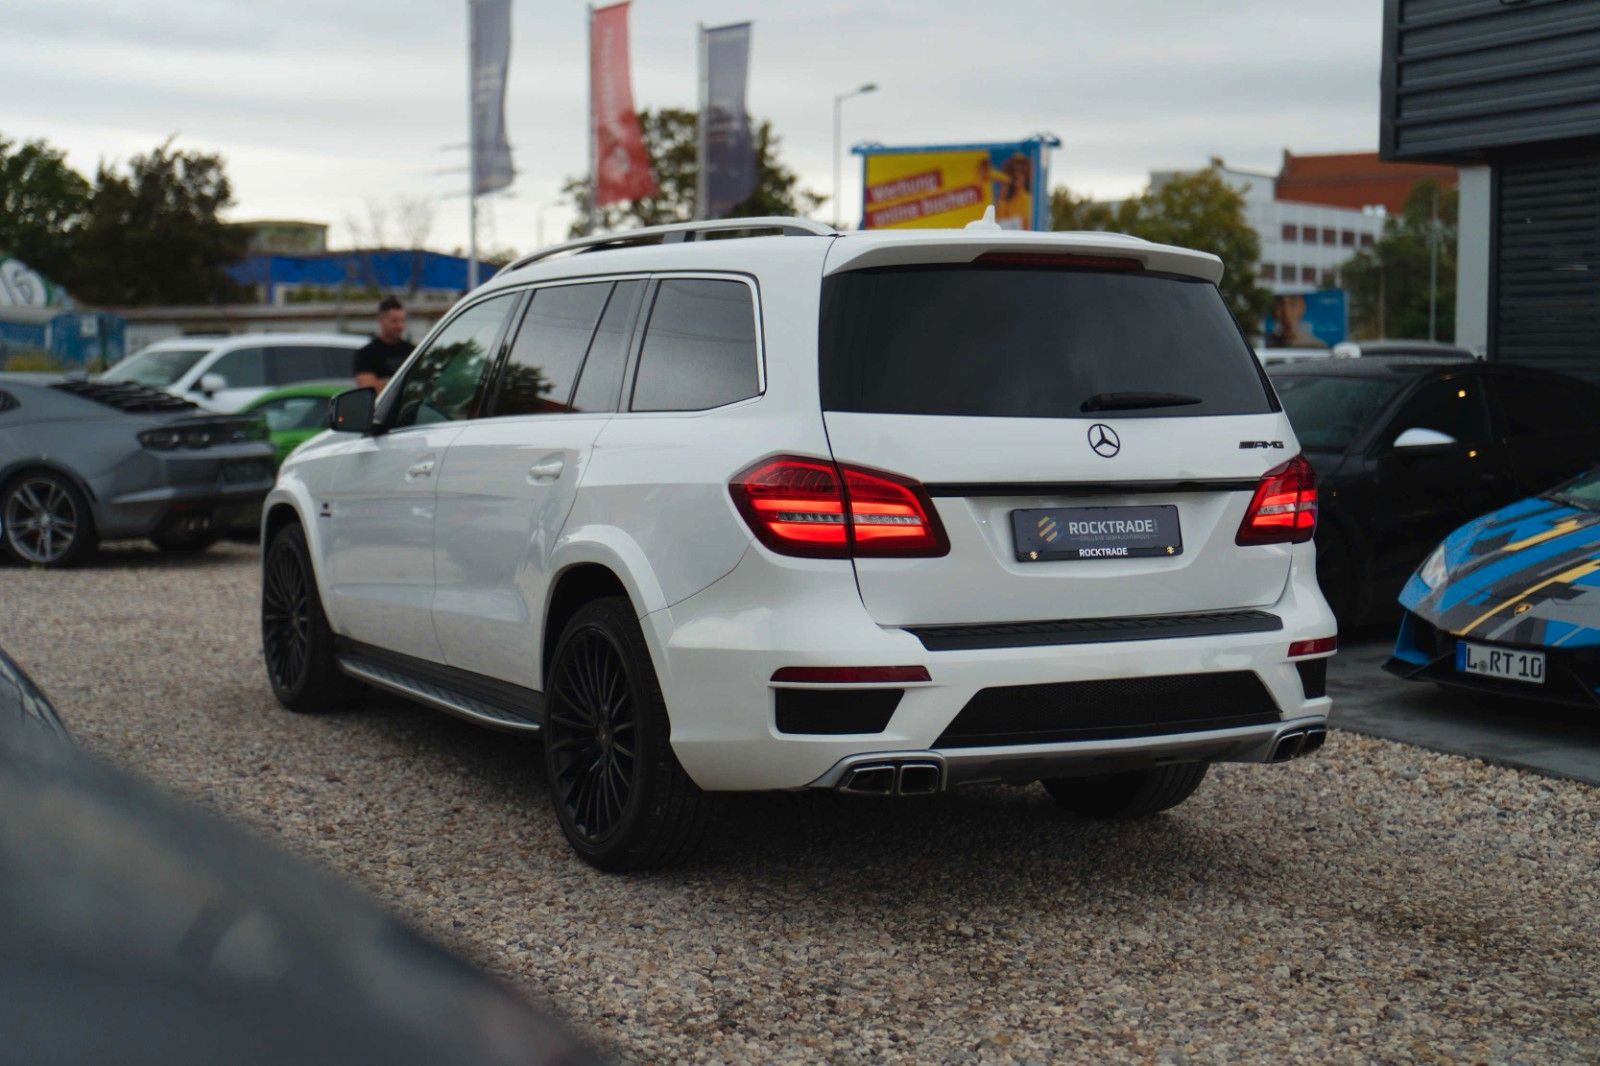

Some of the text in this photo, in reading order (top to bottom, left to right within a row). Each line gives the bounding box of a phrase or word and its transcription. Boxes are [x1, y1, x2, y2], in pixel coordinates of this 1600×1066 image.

[1068, 519, 1154, 535] ROCKTRADE
[1079, 547, 1128, 558] ROCKTRADE
[1466, 647, 1542, 679] L RT 10
